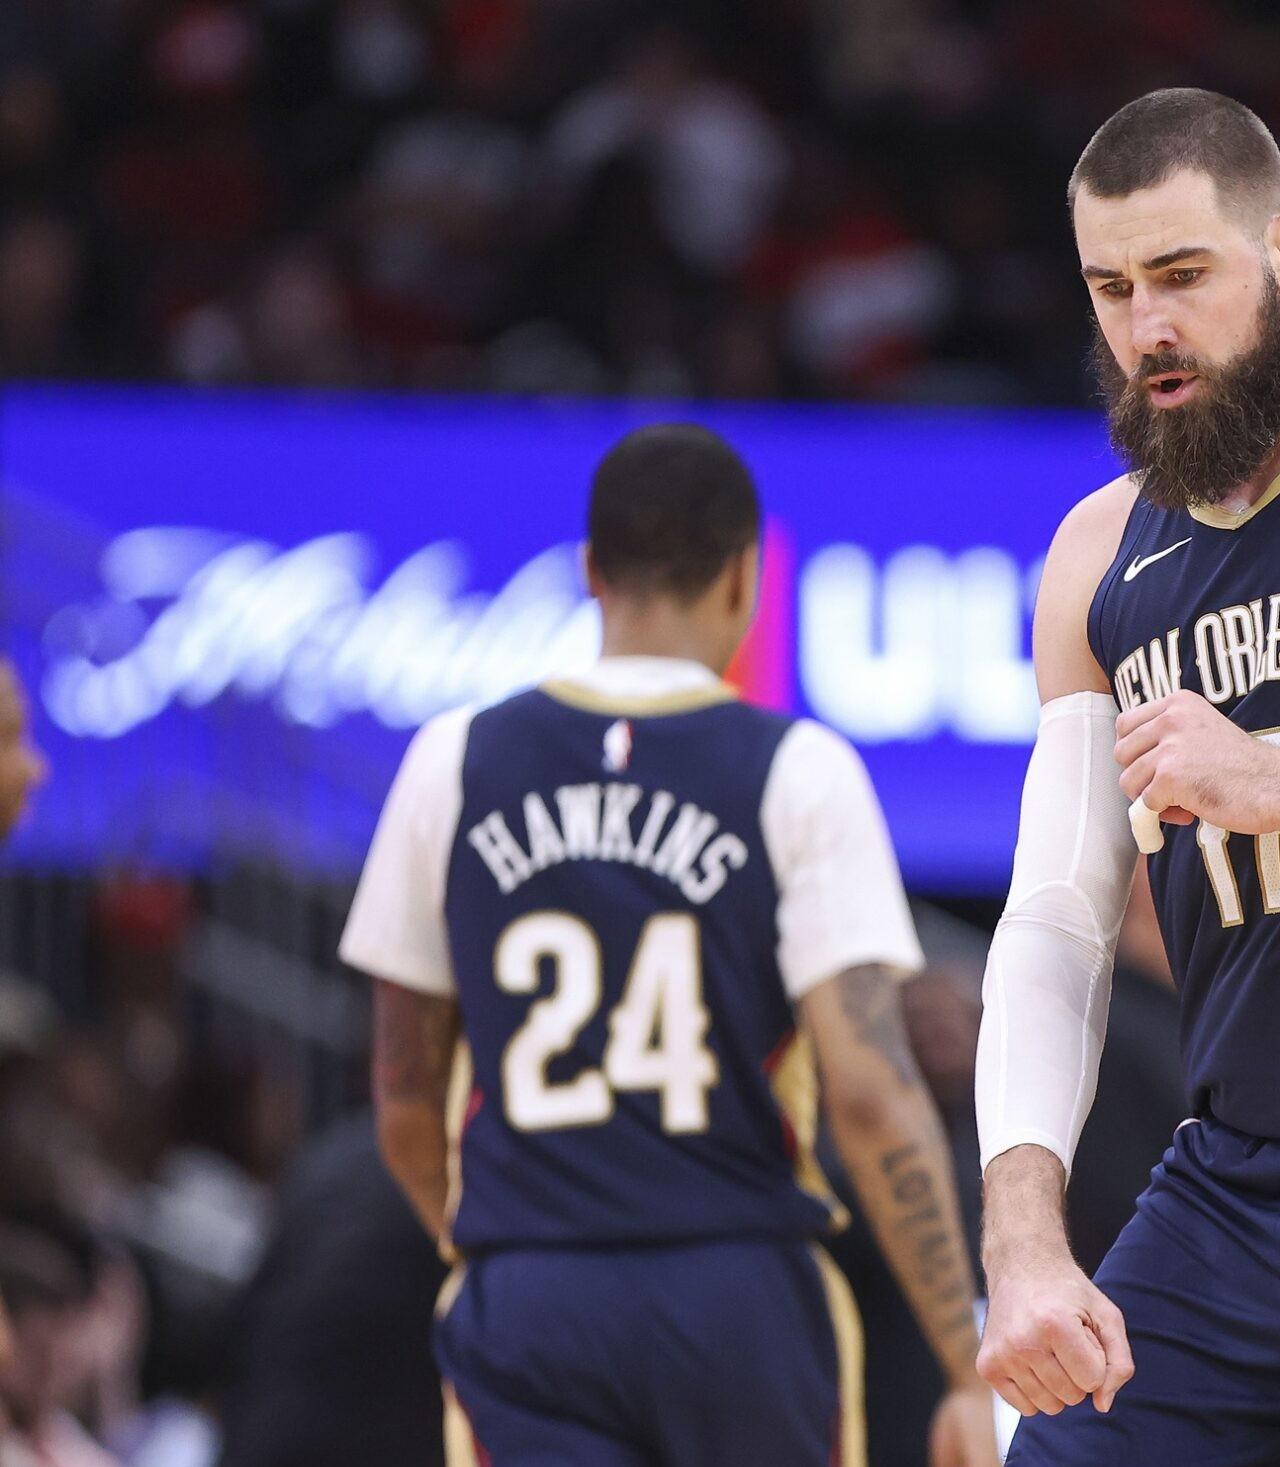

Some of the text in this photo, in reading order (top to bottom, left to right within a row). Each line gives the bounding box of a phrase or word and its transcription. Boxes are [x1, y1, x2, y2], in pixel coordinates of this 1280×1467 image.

[798, 542, 1046, 745] UL
[467, 782, 748, 905] HAWKINS
[494, 909, 720, 1134] 24
